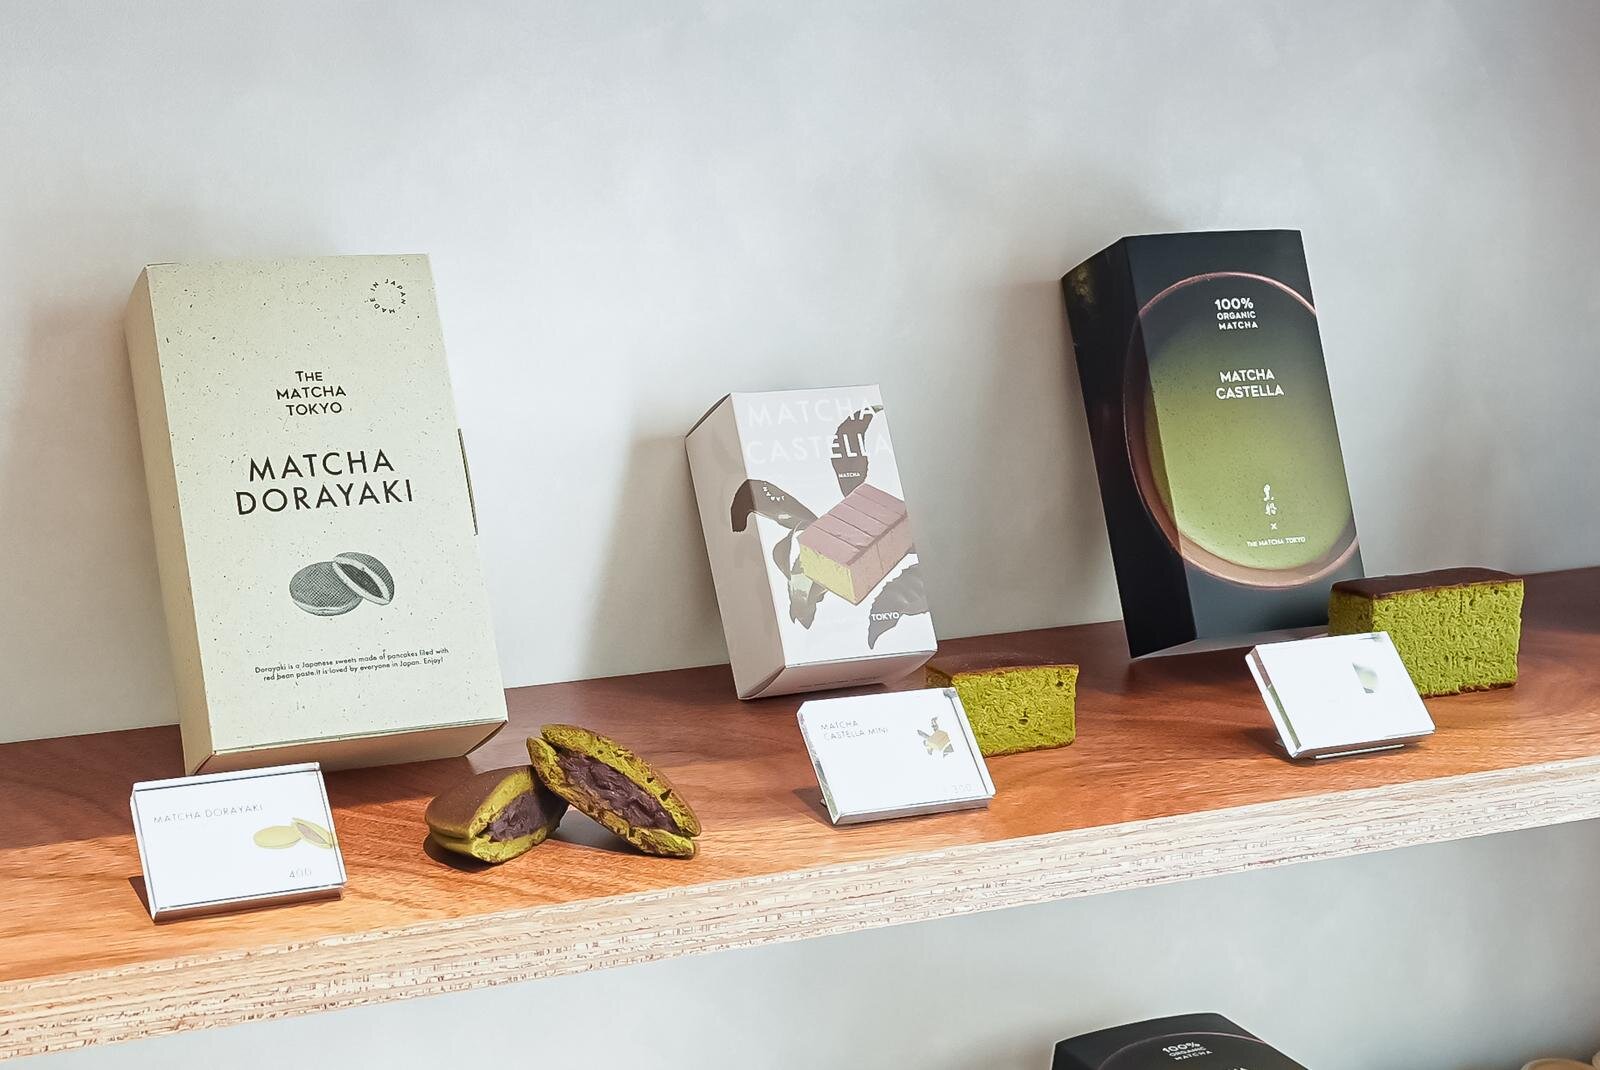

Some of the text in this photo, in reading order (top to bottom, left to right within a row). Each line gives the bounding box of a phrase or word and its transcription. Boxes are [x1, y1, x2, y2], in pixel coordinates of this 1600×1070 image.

[370, 278, 406, 314] MADE IN JAPAN
[1214, 297, 1254, 310] 100%
[1216, 311, 1256, 320] ORGANIC
[1218, 321, 1259, 330] MATCHA
[1219, 368, 1275, 383] MATCHA
[276, 385, 347, 400] MATCHA
[1216, 384, 1285, 400] CASTELLA
[286, 401, 343, 416] TOKYO
[746, 396, 878, 428] MATCHA
[749, 432, 893, 465] CASTELLA
[249, 449, 395, 482] MATCHA
[235, 479, 414, 515] DORAYAKI
[1259, 538, 1285, 546] MATCHA
[871, 611, 900, 621] TOKYO
[254, 662, 287, 674] Dorayaki
[302, 660, 334, 668] Japanese
[335, 657, 357, 665] sweets
[359, 654, 378, 662] made
[387, 651, 418, 660] pancakes
[263, 673, 275, 681] red
[277, 672, 295, 681] bean
[349, 665, 358, 673] by
[360, 663, 390, 671] everyone
[820, 719, 859, 730] MATCHA
[153, 804, 263, 823] MATCHA DORAYAKI
[1162, 1041, 1201, 1053] 100%
[1174, 1050, 1213, 1060] MATCHA
